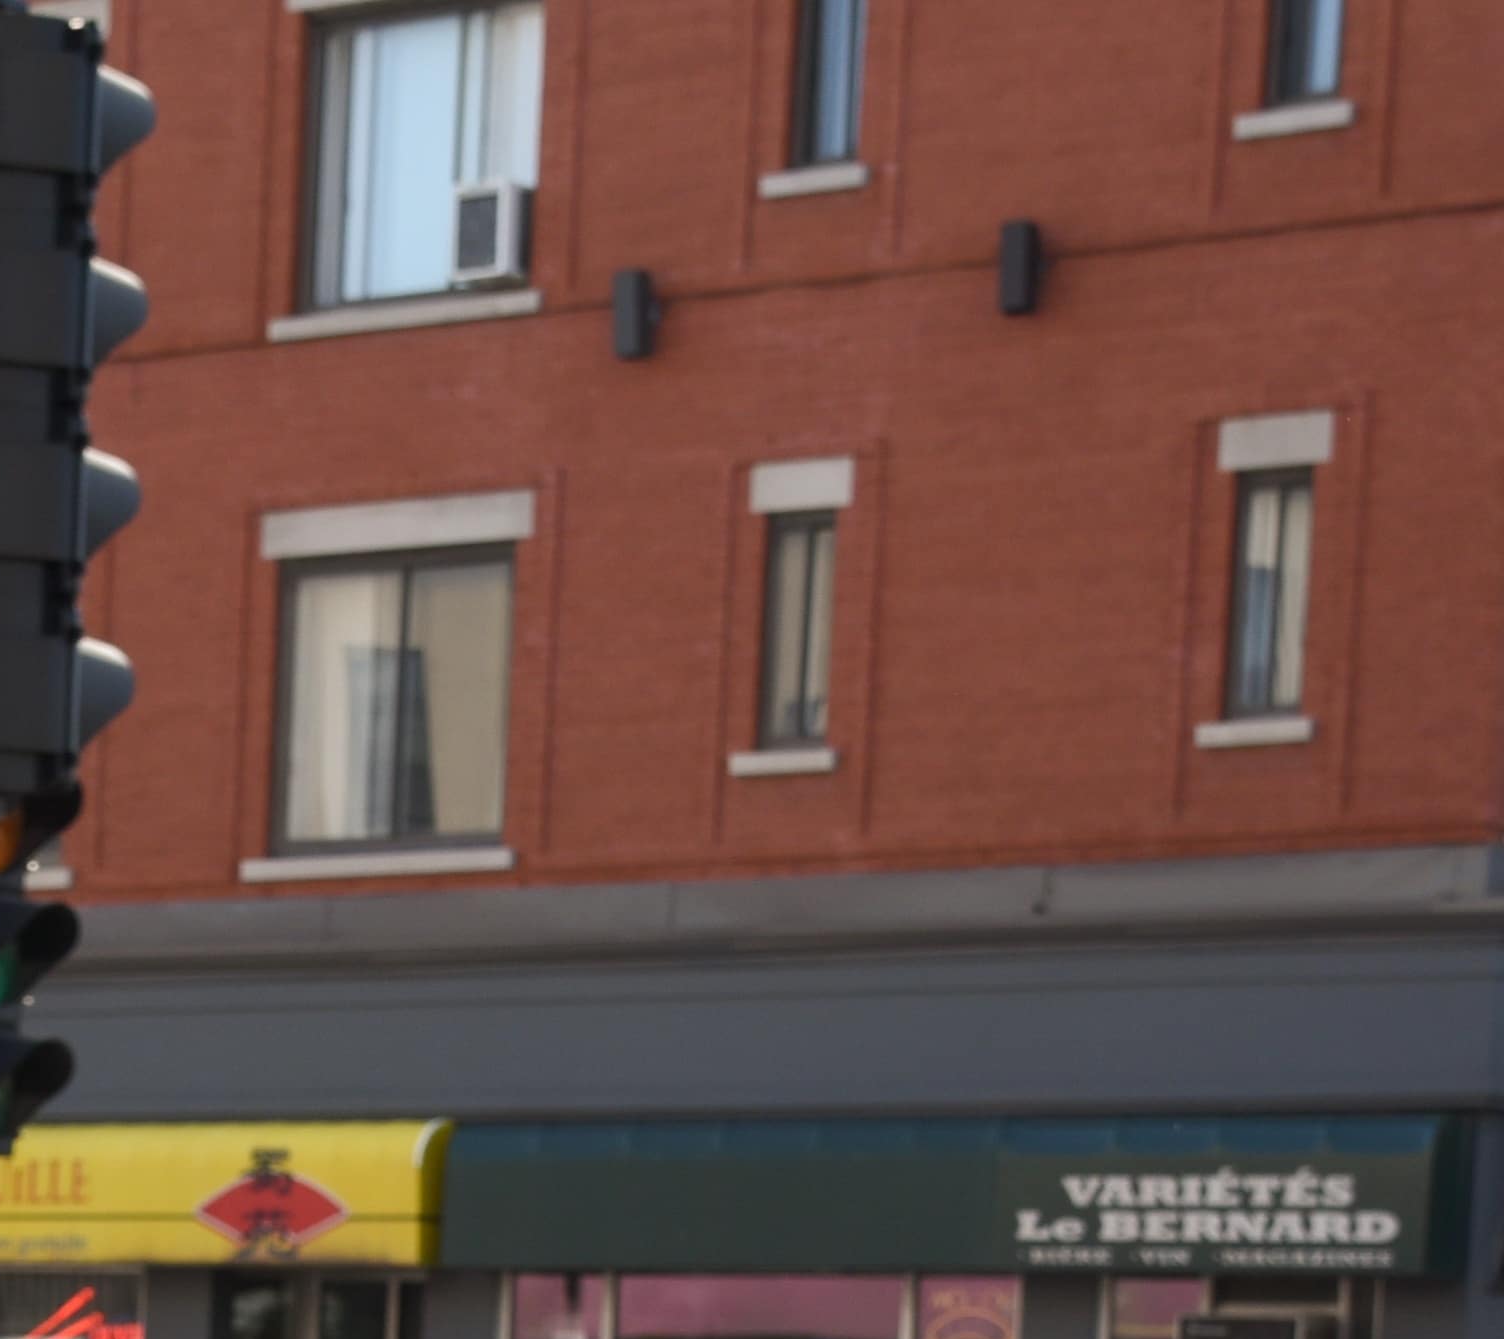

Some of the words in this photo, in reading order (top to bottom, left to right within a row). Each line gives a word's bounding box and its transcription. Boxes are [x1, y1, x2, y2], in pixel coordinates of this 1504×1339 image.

[1060, 1165, 1356, 1208] VARIÉTÉS
[1015, 1209, 1086, 1243] Le
[1098, 1208, 1401, 1245] BERNARD
